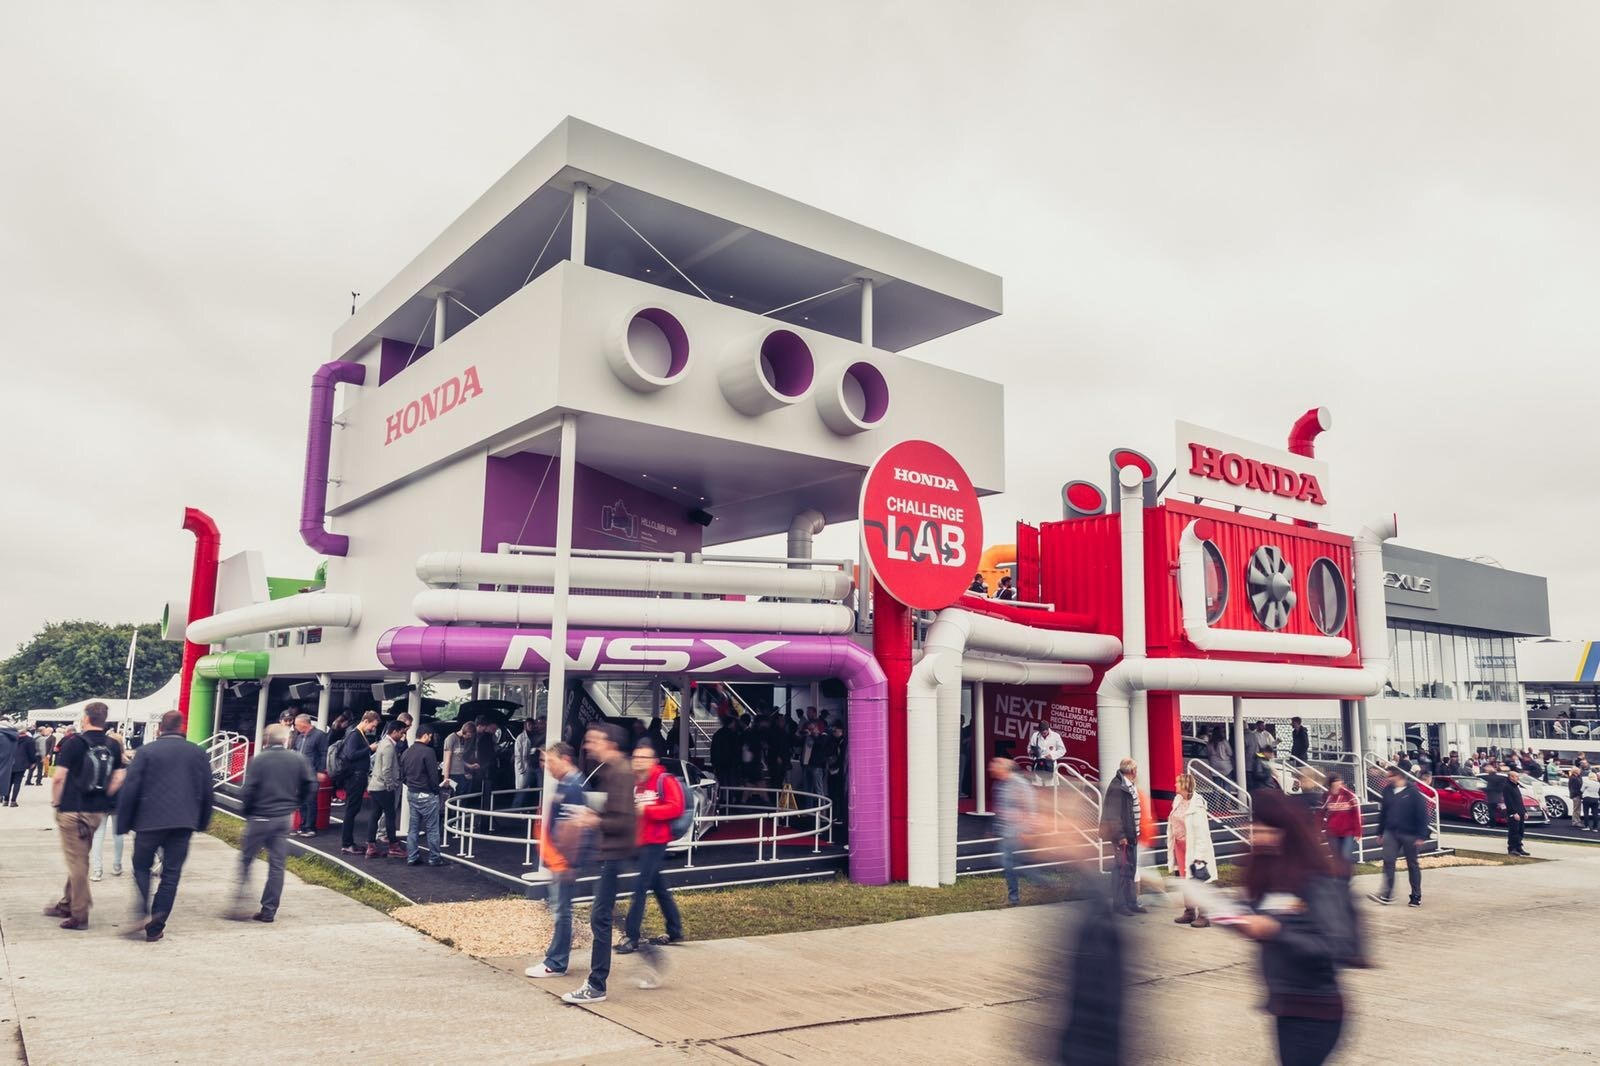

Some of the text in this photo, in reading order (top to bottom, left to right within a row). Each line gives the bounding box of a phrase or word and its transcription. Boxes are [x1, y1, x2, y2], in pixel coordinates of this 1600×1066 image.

[384, 365, 484, 447] HONDA
[894, 467, 960, 492] HONDA
[1188, 442, 1328, 506] HONDA
[886, 496, 965, 523] CHALLENGE
[887, 515, 967, 568] LAB
[1383, 571, 1432, 593] EXUS
[501, 635, 792, 674] NSX
[995, 693, 1047, 720] NEXT
[1050, 710, 1098, 724] CHALLENGES AN
[1051, 703, 1095, 717] COMPLETE THE
[993, 715, 1041, 741] LEVE
[1049, 722, 1097, 737] LIMITED EDITION
[1050, 716, 1092, 729] RECEIVE YOUR
[1054, 730, 1087, 742] GLASSES
